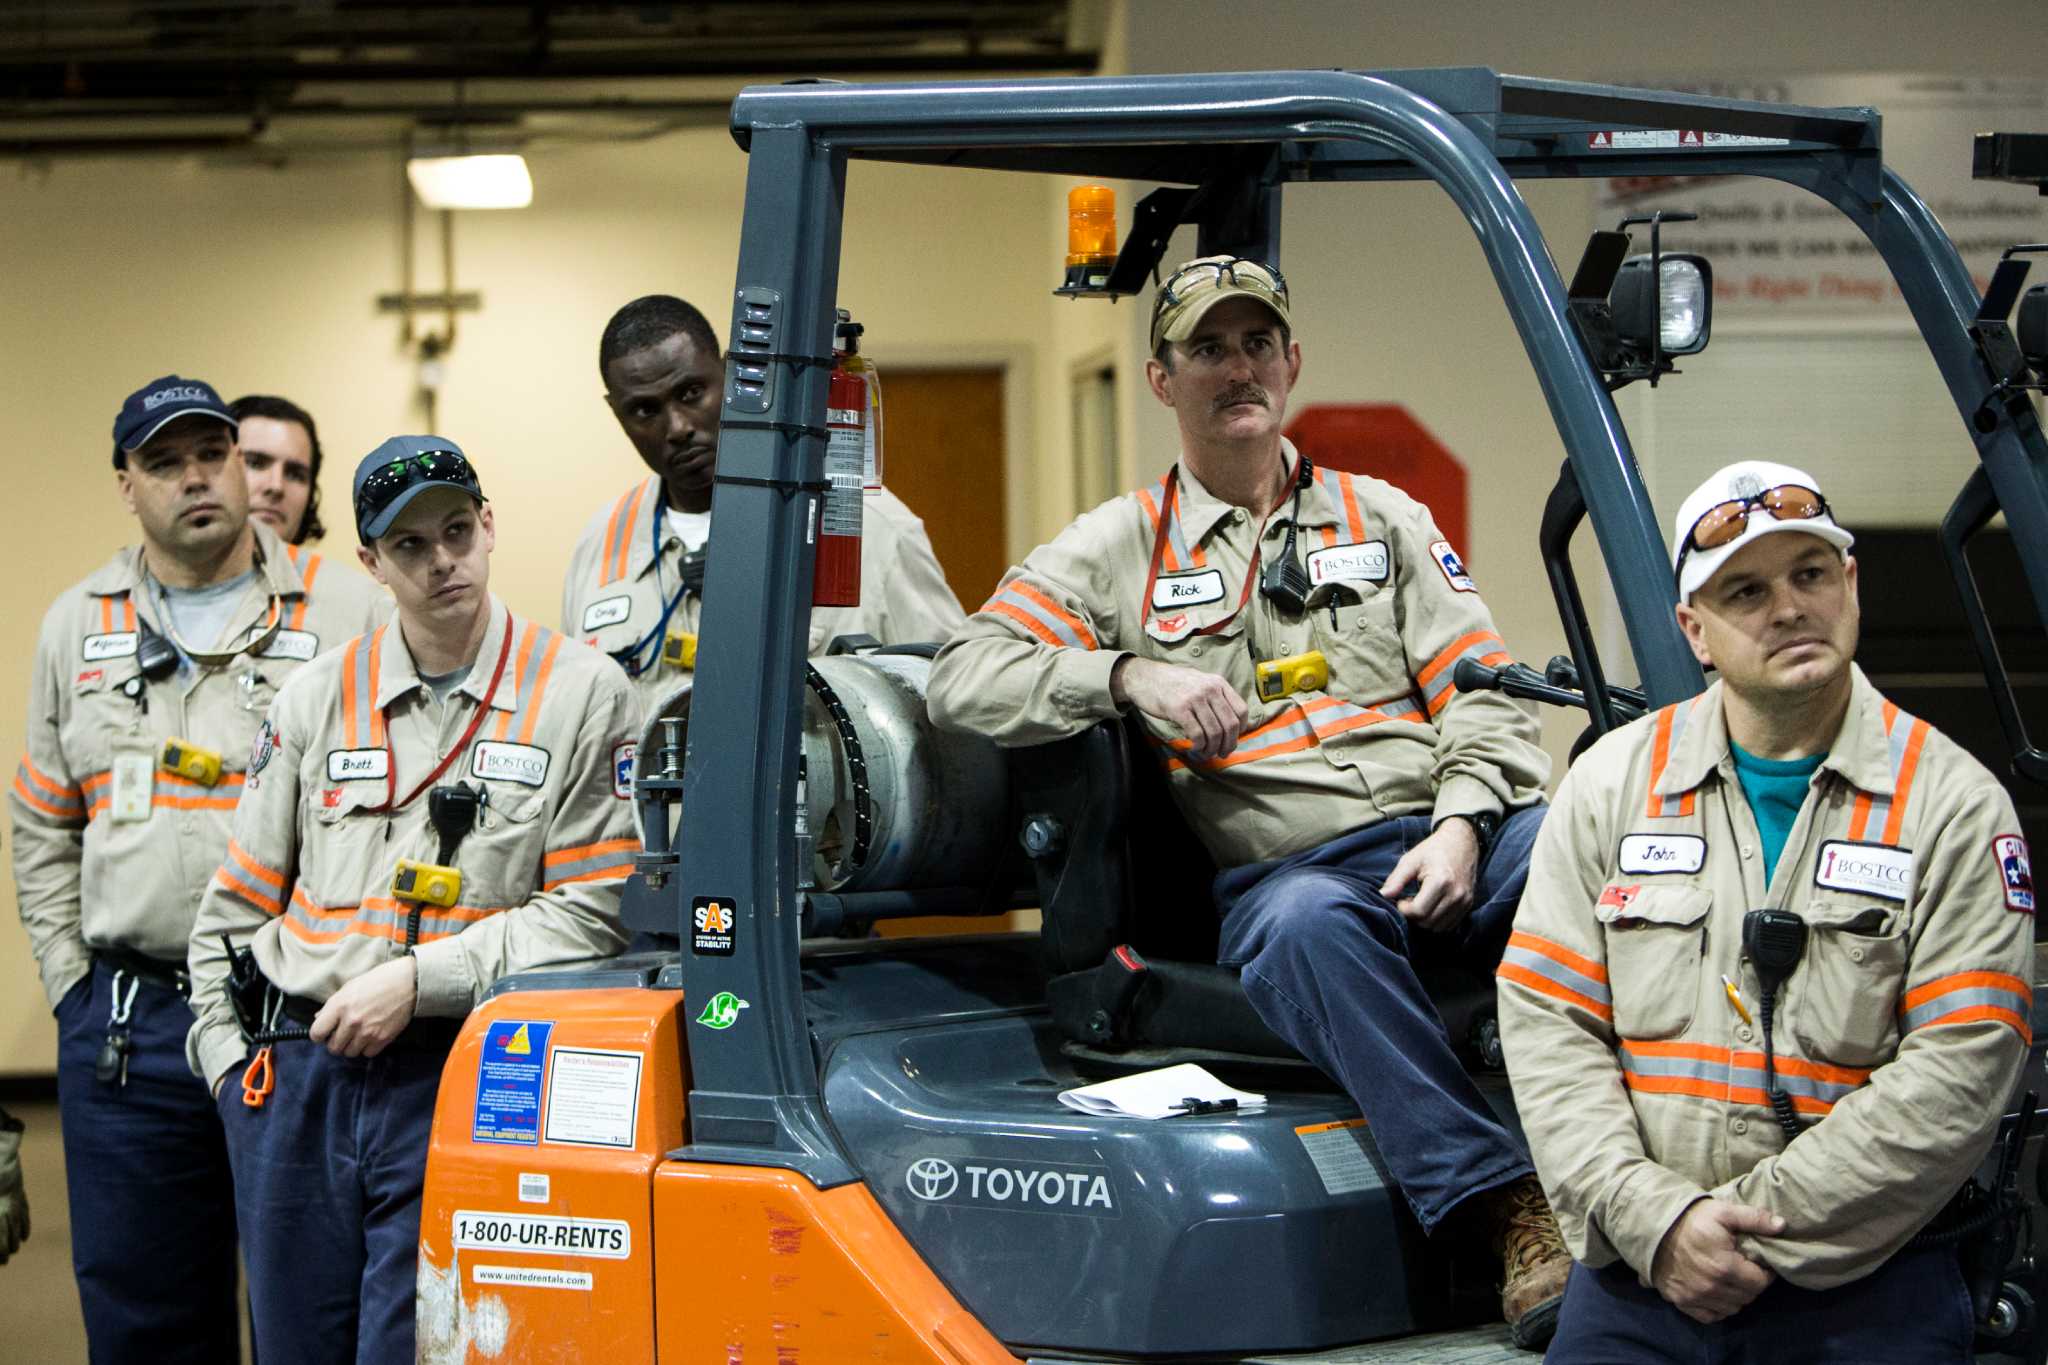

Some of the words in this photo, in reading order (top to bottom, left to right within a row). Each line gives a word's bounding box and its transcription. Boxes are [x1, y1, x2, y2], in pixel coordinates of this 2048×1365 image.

[1324, 553, 1385, 571] BOSTCO
[1171, 583, 1202, 598] Rick
[342, 758, 374, 771] Brett
[487, 754, 543, 774] BOSTCO
[1641, 844, 1678, 861] John
[694, 902, 733, 934] SAS
[695, 940, 732, 949] STABILITY
[965, 1166, 1114, 1209] TOYOTA
[459, 1220, 623, 1250] 1-800-UR-RENTS
[479, 1270, 587, 1286] www.unitedrentals.com
